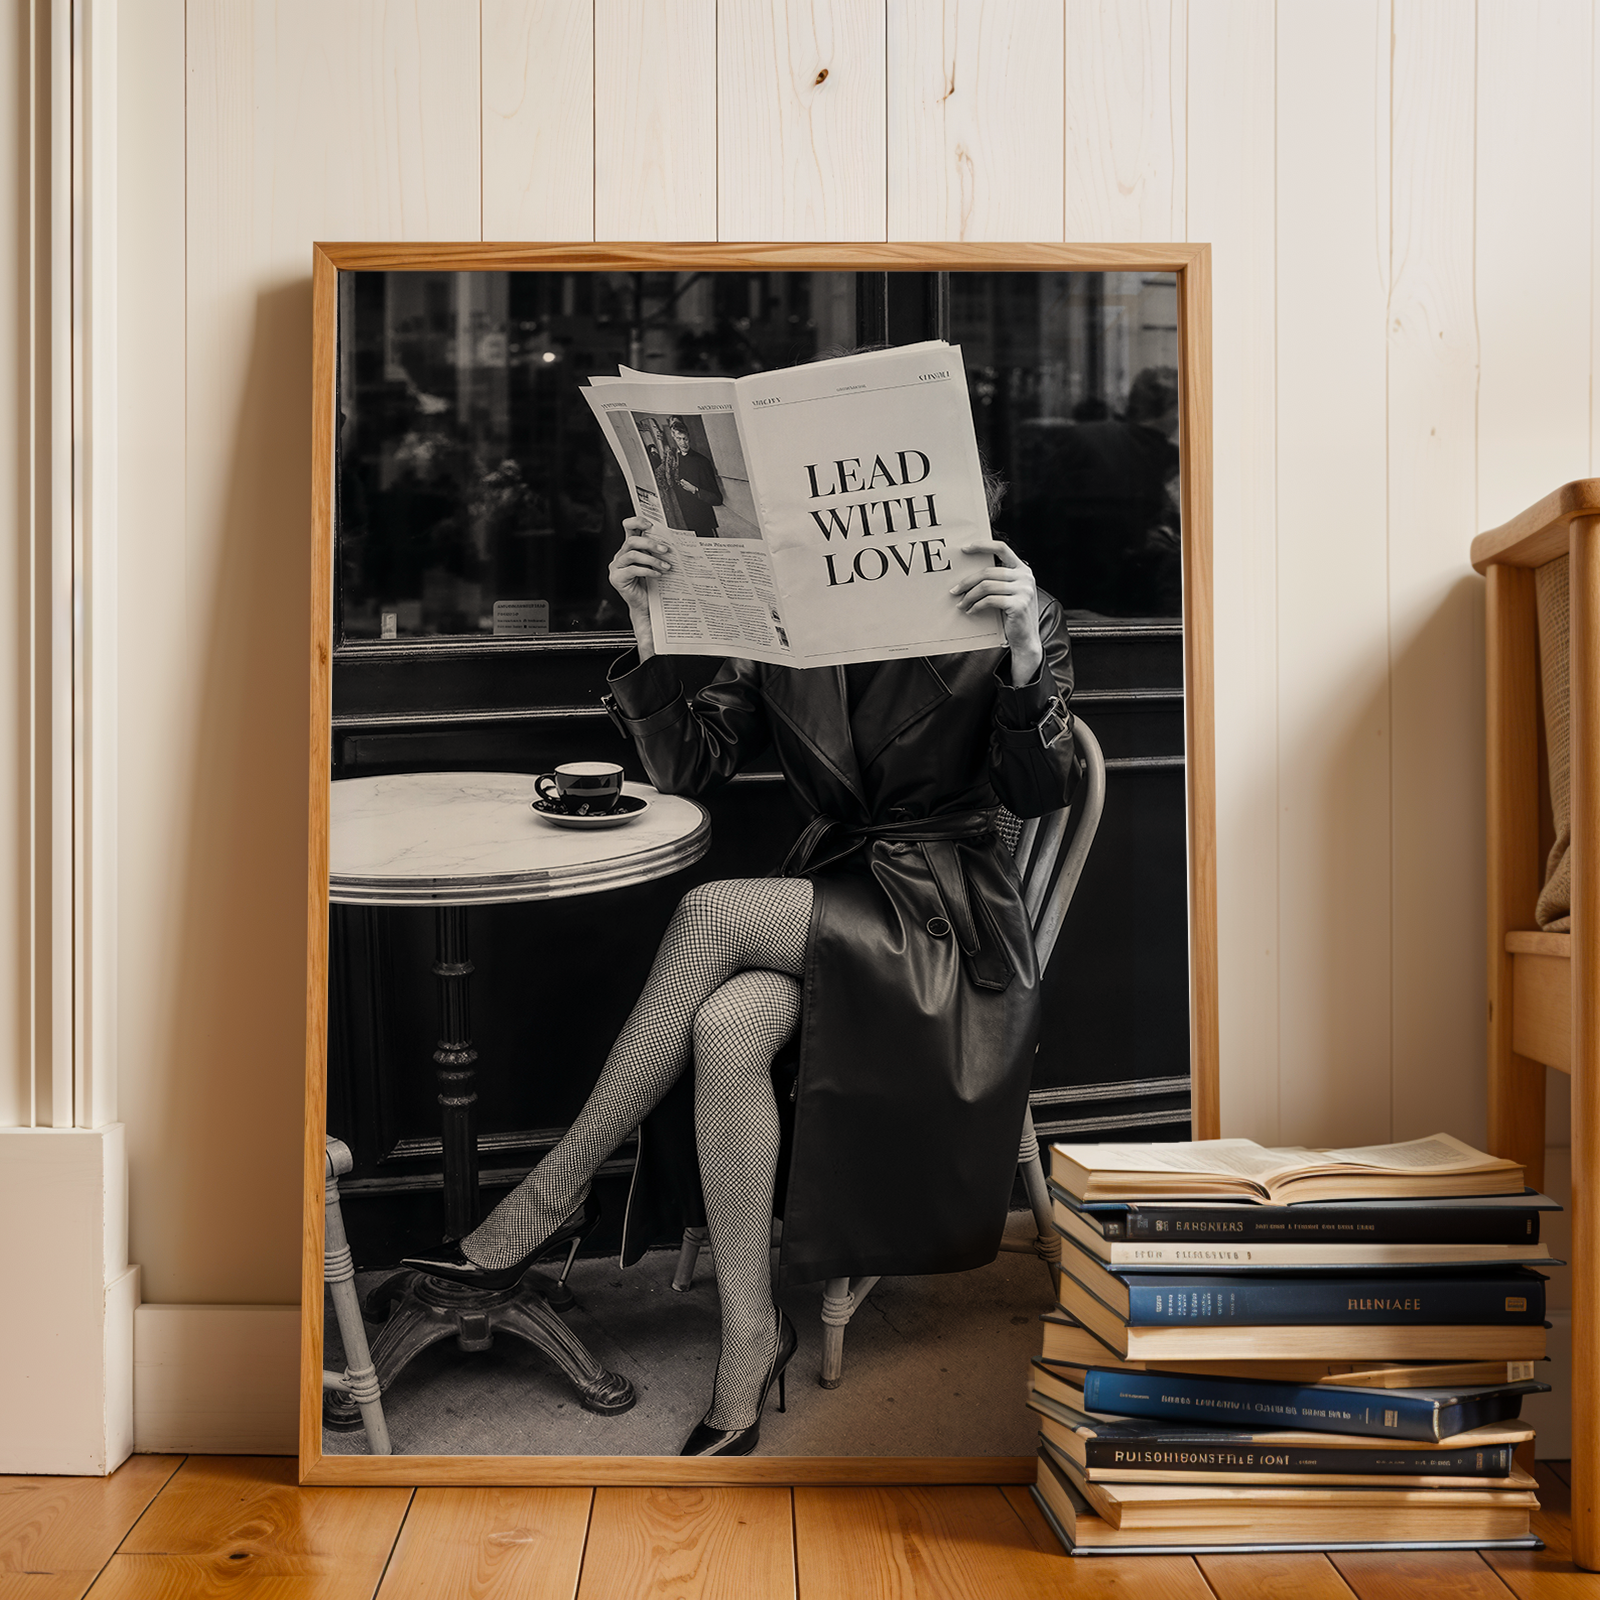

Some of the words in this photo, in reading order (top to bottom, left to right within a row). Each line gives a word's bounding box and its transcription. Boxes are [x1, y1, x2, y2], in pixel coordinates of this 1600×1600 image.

[804, 449, 931, 498] LEAD
[808, 493, 942, 541] WITH
[822, 538, 952, 587] LOVE
